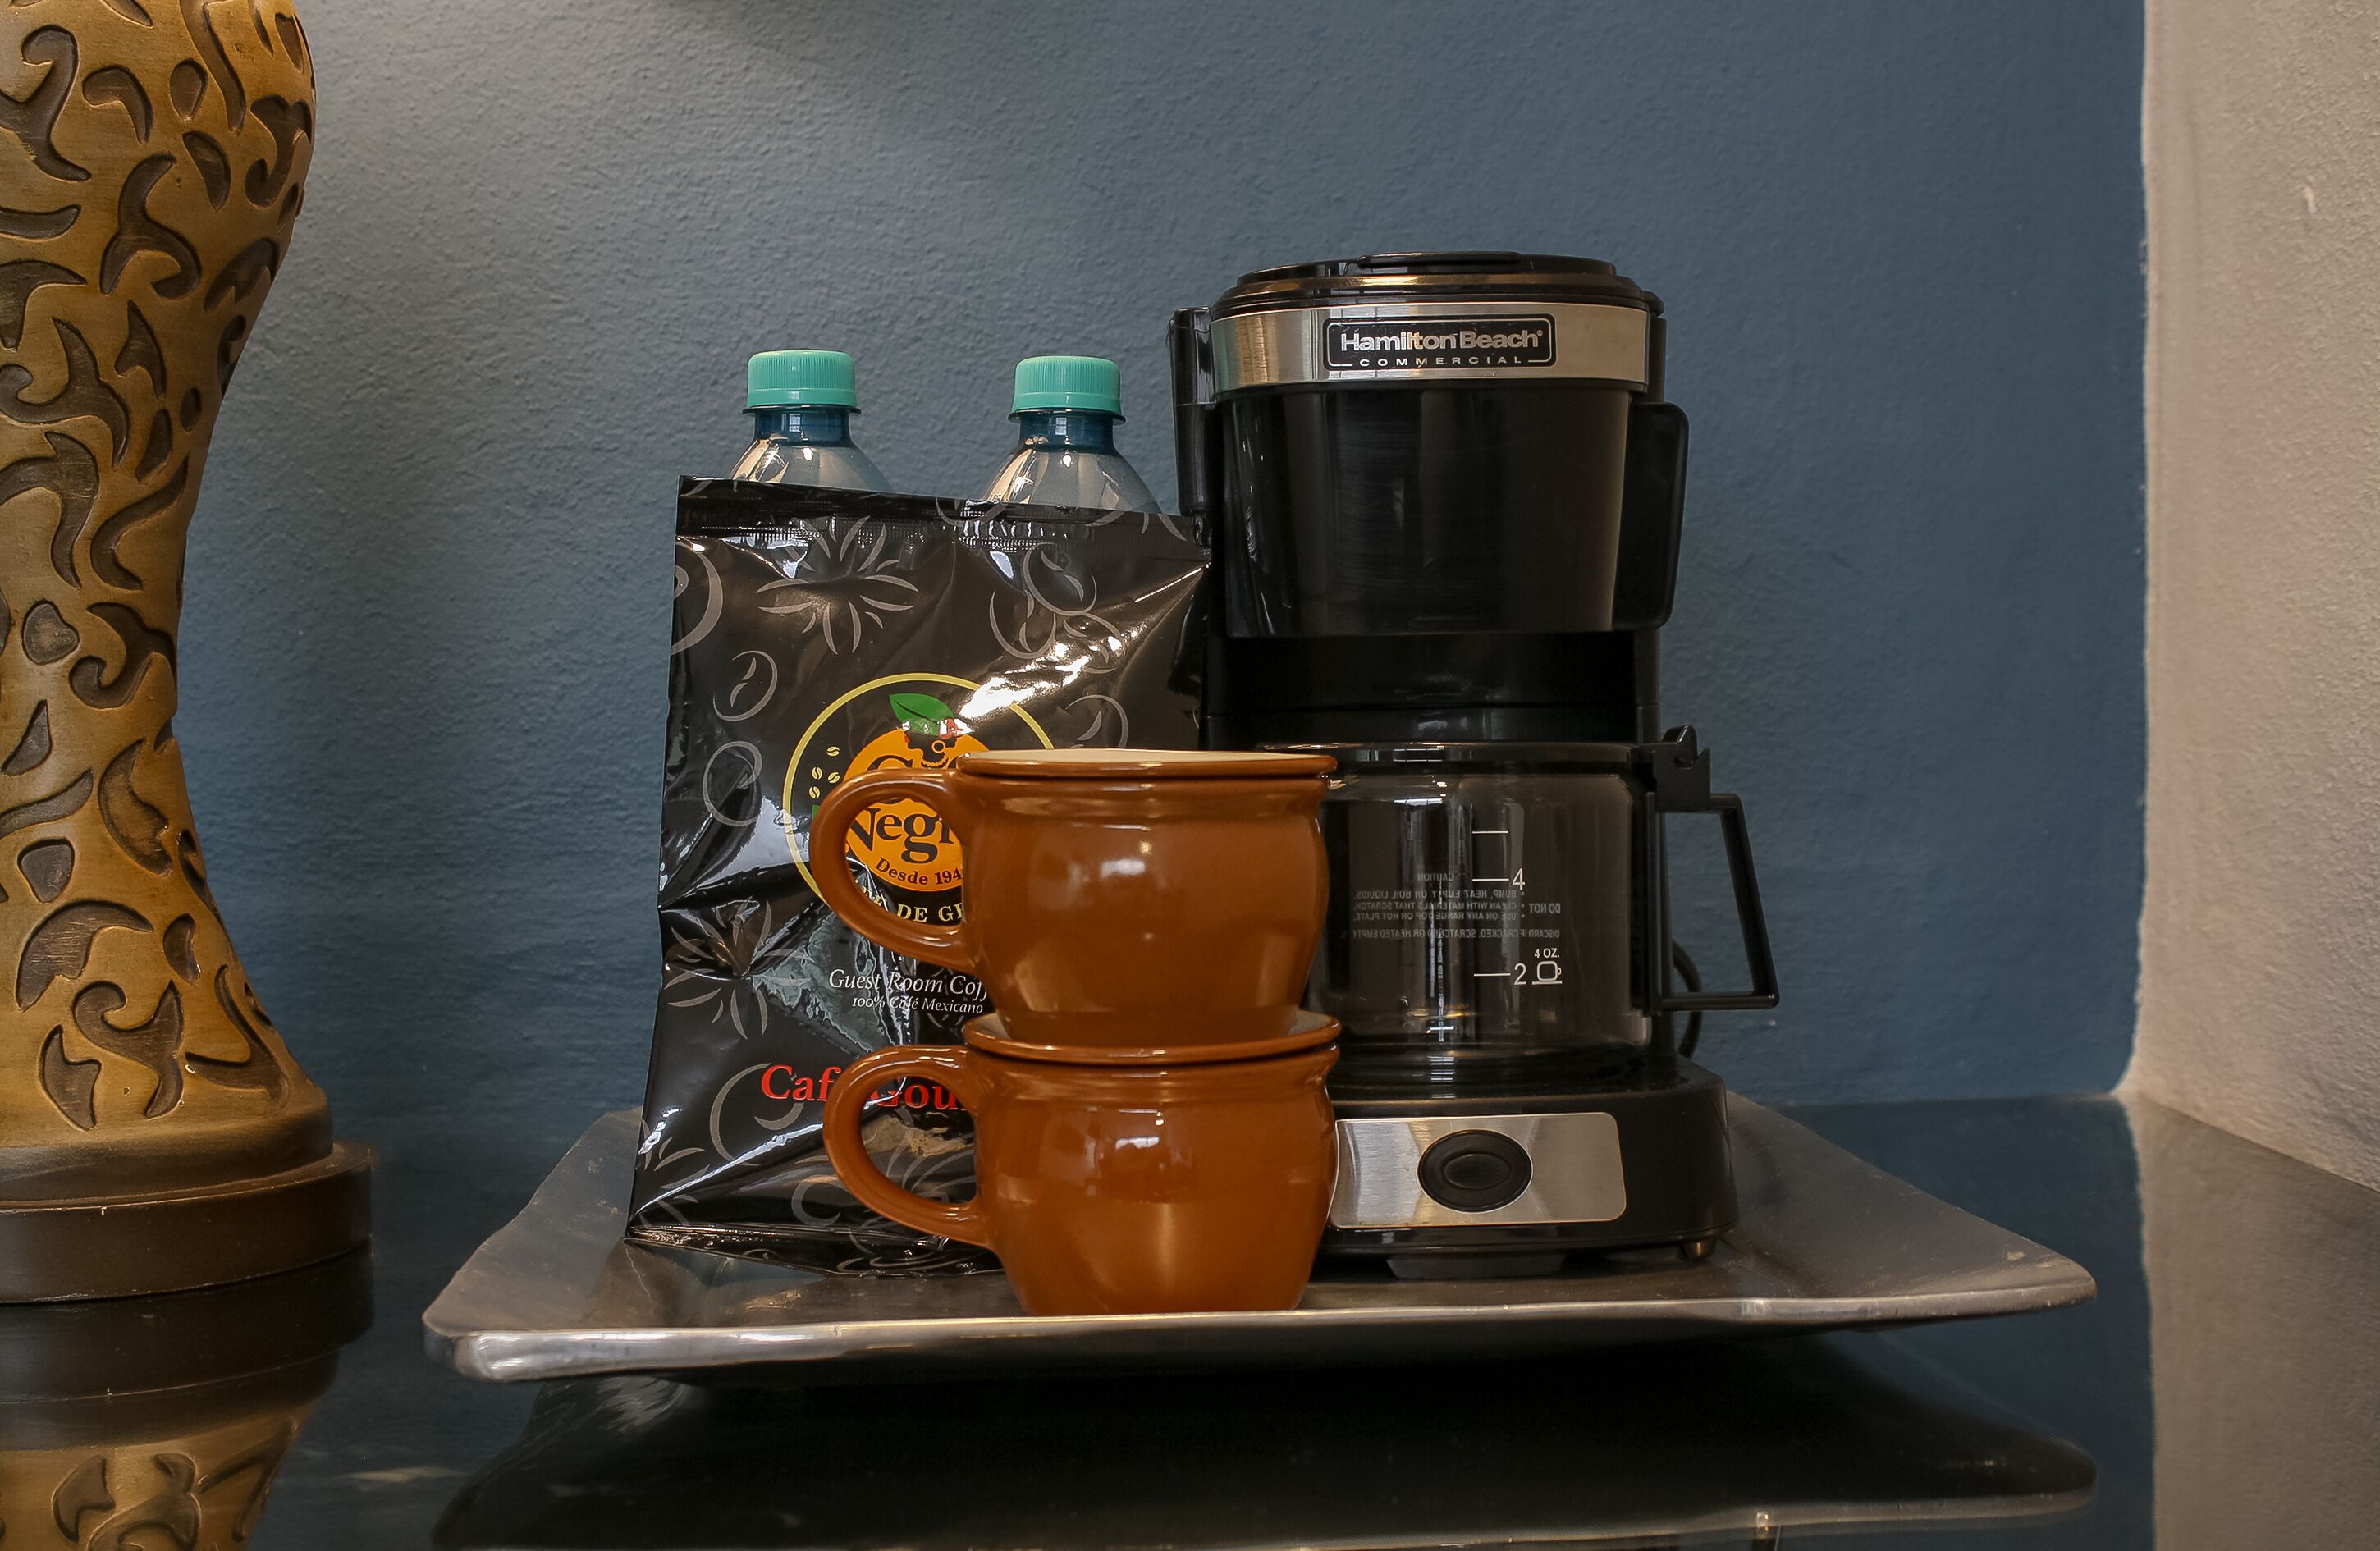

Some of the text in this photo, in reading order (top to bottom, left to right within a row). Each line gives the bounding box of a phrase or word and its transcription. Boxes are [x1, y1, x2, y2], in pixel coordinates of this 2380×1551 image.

[1359, 355, 1522, 367] COMMERCIAL
[849, 808, 954, 864] Negr
[874, 857, 962, 885] Desde 194
[1512, 867, 1526, 890] 4
[897, 903, 927, 922] DE
[1534, 947, 1560, 959] 4 OZ.
[829, 968, 882, 991] Guest
[887, 970, 944, 993] Room
[1513, 963, 1527, 985] 2
[852, 995, 984, 1013] 100% Café Mexicano
[761, 1064, 842, 1101] Caf
